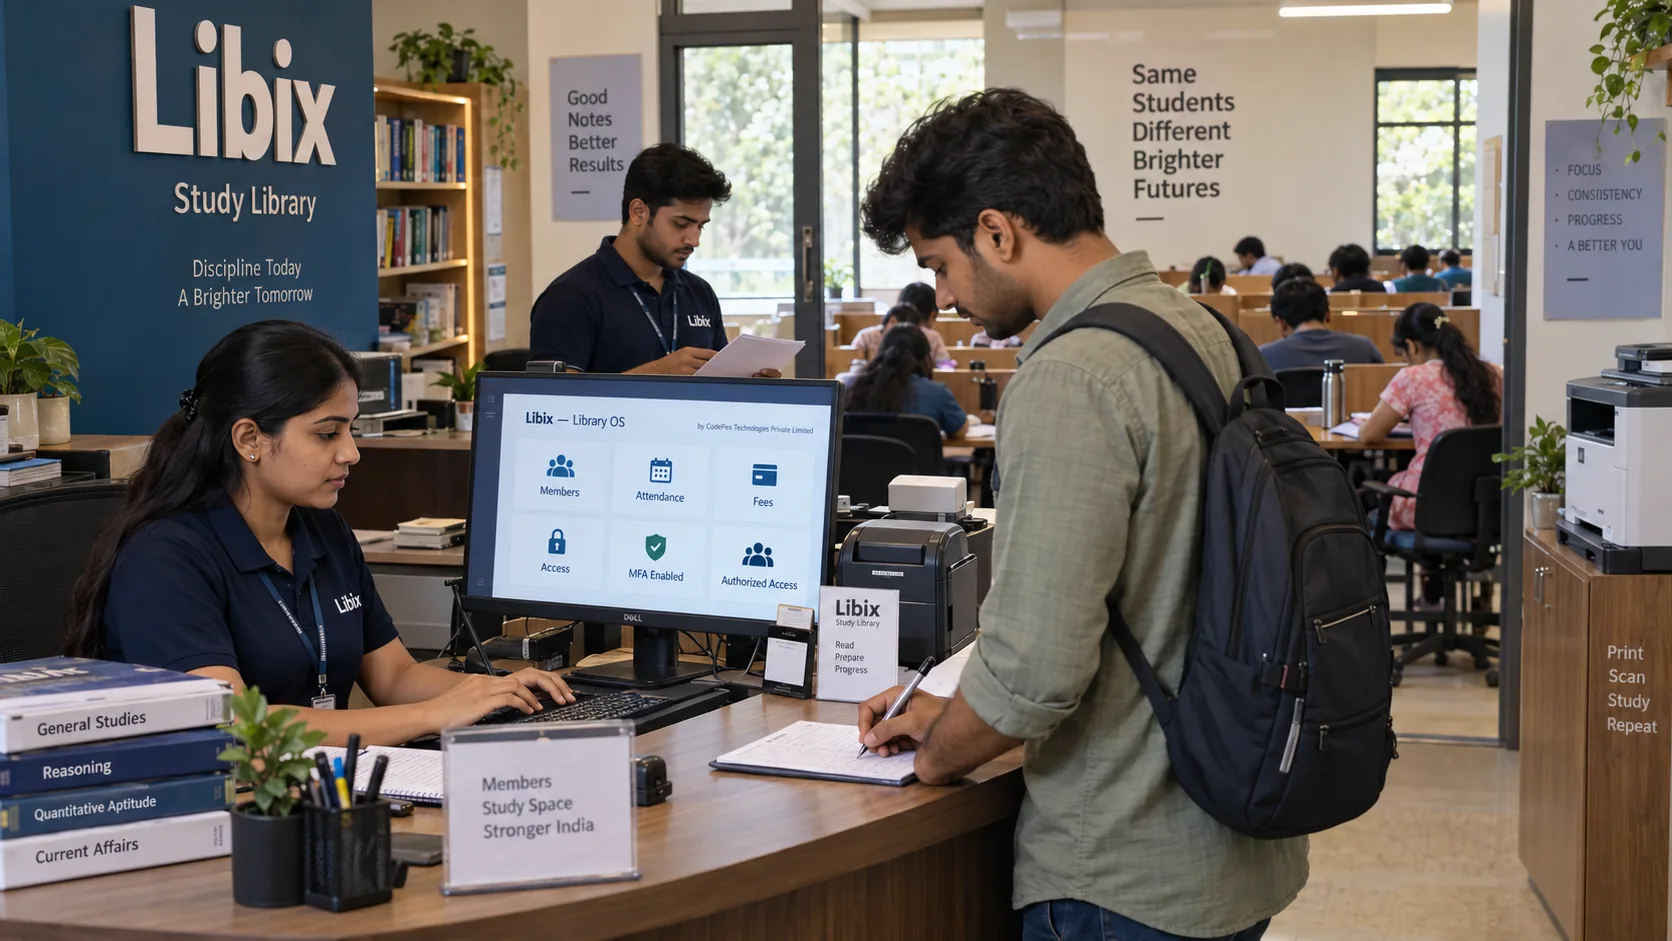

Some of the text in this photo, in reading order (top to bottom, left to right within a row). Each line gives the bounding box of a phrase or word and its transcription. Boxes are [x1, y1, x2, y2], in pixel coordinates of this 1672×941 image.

[1132, 63, 1197, 85] Same
[130, 4, 337, 166] Libix
[567, 88, 608, 106] Good
[1132, 90, 1235, 114] Students
[568, 111, 613, 128] Notes
[1132, 119, 1232, 142] Different
[568, 134, 618, 151] Better
[569, 155, 624, 173] Results
[1133, 148, 1225, 176] Brighter
[1567, 163, 1602, 177] FOCUS
[1134, 178, 1221, 200] Futures
[174, 181, 317, 223] Study Library
[1567, 213, 1623, 226] PROGRESS
[1567, 238, 1643, 252] A BETTER YOU
[193, 257, 302, 281] Discipline Today
[177, 286, 314, 310] A Brighter Tomorrow
[687, 314, 712, 328] Libix
[525, 411, 554, 425] Libix
[573, 414, 608, 430] Library
[609, 415, 626, 428] OS
[697, 422, 705, 431] by
[733, 423, 770, 434] Technologies
[540, 485, 580, 498] Members
[635, 490, 685, 503] Attendance
[753, 496, 774, 508] Fees
[540, 562, 571, 574] Access
[628, 568, 684, 582] MFA Enabled
[720, 575, 798, 591] Authorized Access
[334, 592, 362, 614] Libix
[835, 598, 881, 618] Libix
[623, 613, 643, 623] DELL
[835, 618, 881, 629] Study Library
[835, 640, 855, 650] Read
[1607, 644, 1644, 661] Print
[835, 652, 865, 663] Prepare
[835, 664, 868, 676] Progress
[1608, 668, 1646, 685] Scan
[1607, 692, 1651, 712] Study
[37, 711, 147, 737] General Studies
[1607, 717, 1658, 736] Repeat
[43, 760, 112, 780] Reasoning
[482, 774, 553, 792] Members
[34, 795, 157, 822] Quantitative Aptitude
[482, 797, 573, 817] Study Space
[483, 816, 595, 840] Stronger India
[35, 838, 139, 864] Current Affairs
